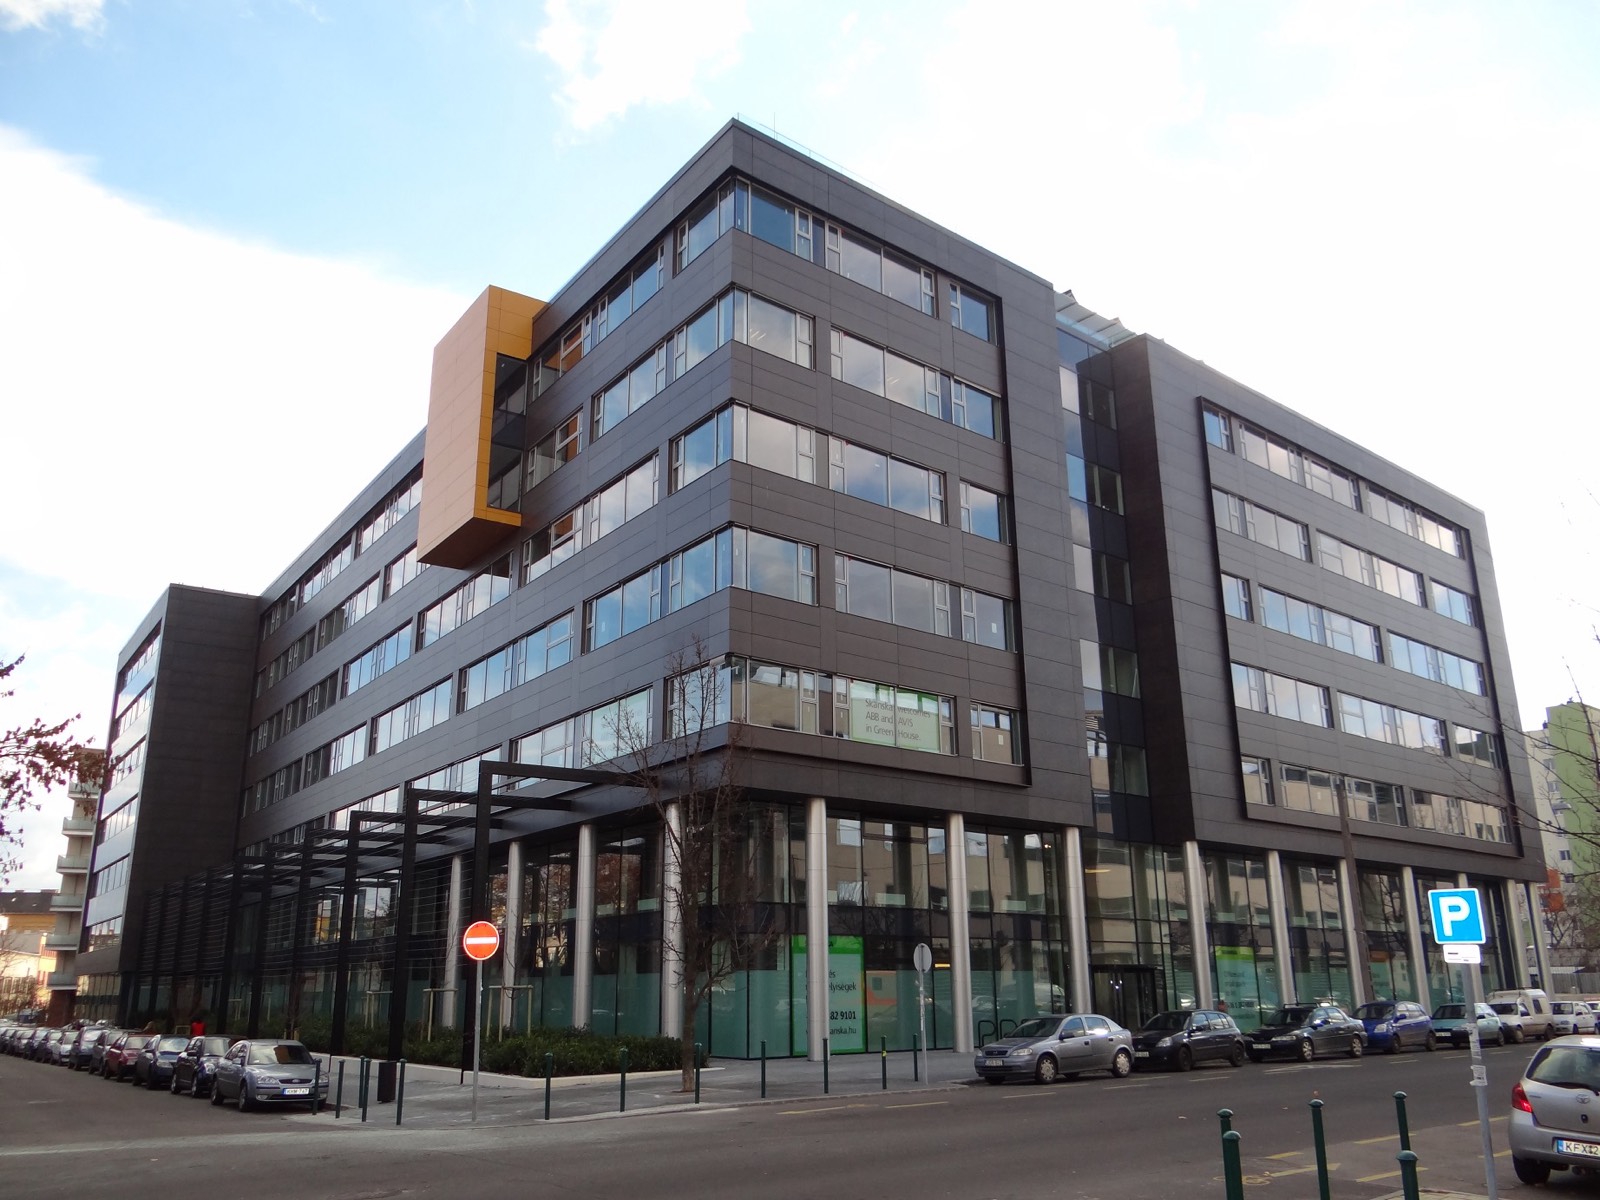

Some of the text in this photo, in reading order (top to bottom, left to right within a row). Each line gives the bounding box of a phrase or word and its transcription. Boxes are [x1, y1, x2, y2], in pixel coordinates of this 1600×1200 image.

[865, 711, 914, 727] ABB and AVIS
[866, 724, 872, 733] in
[874, 725, 894, 736] Green
[1439, 896, 1470, 937] P
[840, 1011, 856, 1020] 9101
[829, 1027, 856, 1035] anska.hu
